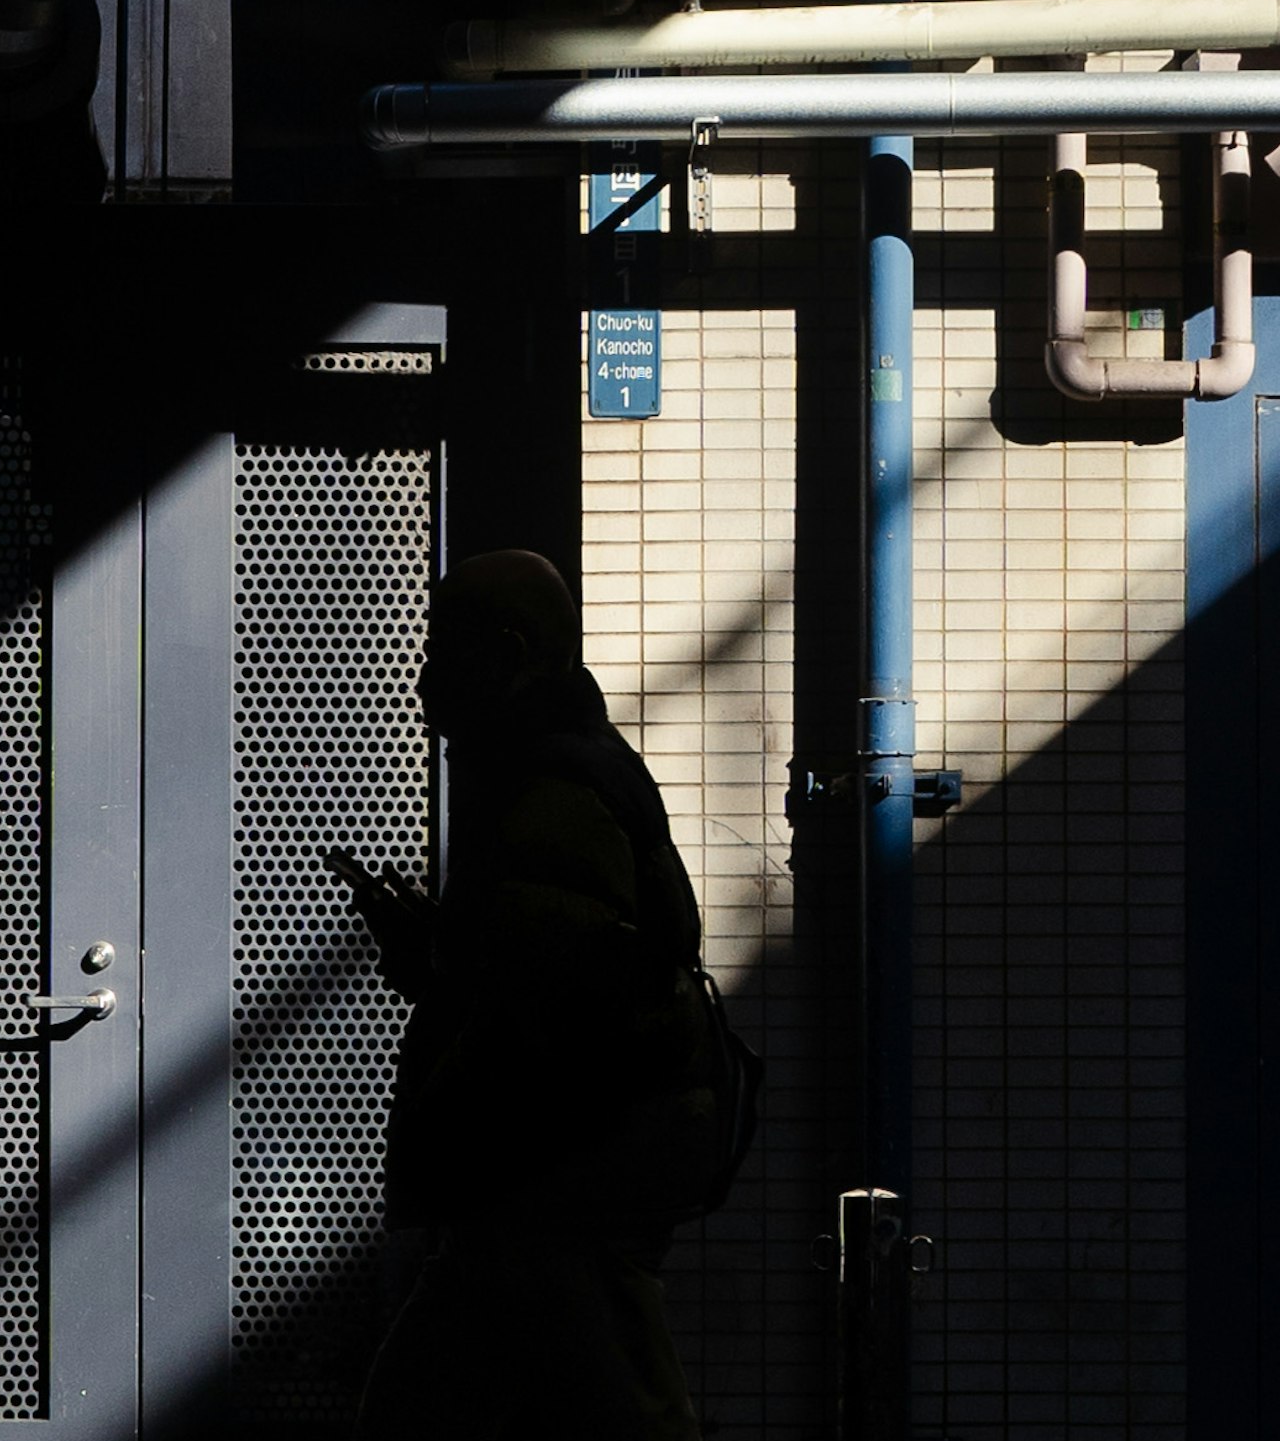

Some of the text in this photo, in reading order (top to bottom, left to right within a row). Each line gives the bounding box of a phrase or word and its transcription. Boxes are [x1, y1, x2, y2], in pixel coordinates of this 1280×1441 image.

[596, 313, 654, 332] Chuo-ku
[596, 338, 654, 356] Kanocho
[597, 361, 654, 380] 4-chome
[619, 386, 631, 408] 1
